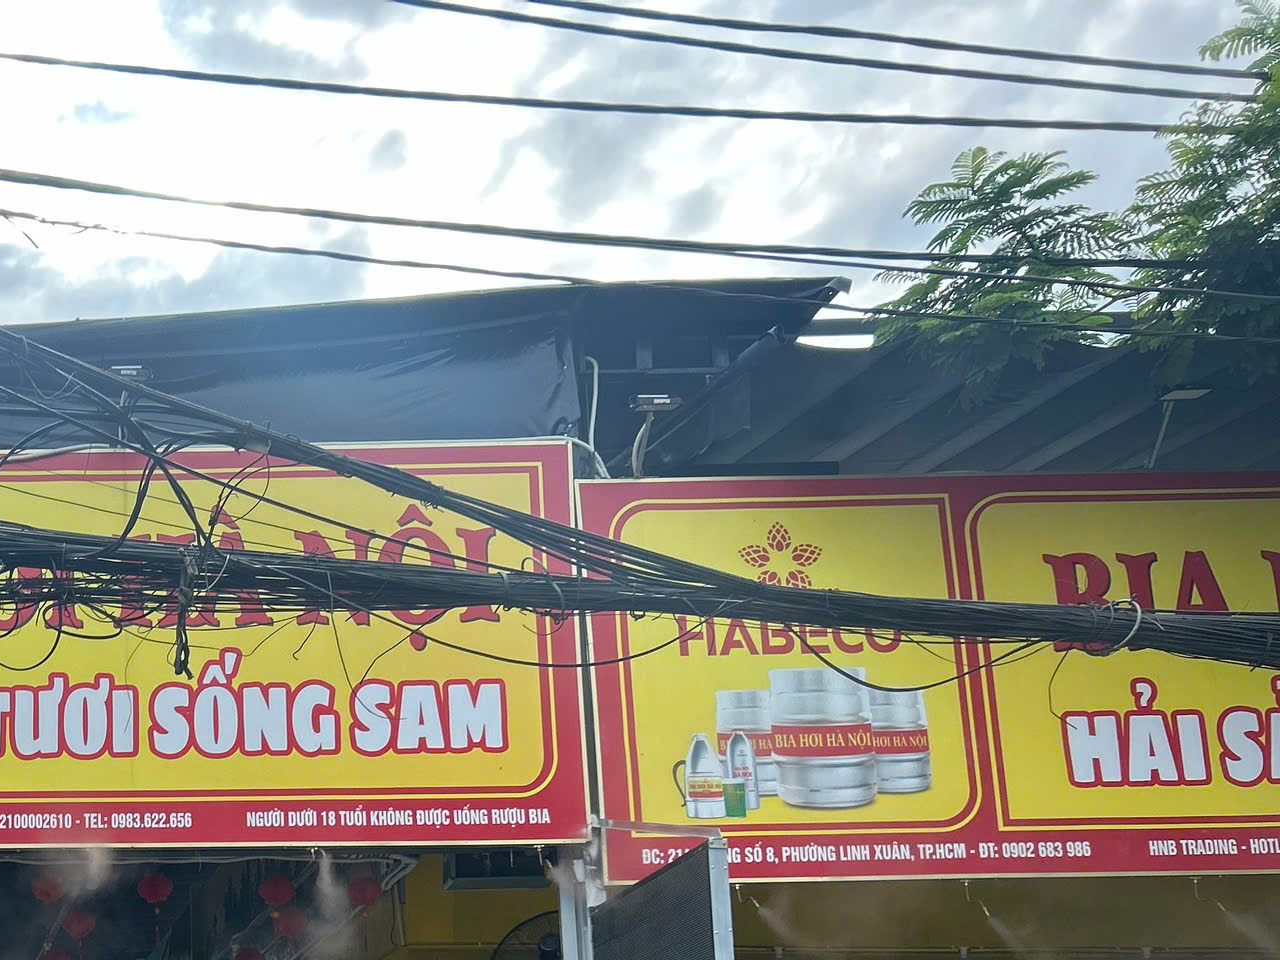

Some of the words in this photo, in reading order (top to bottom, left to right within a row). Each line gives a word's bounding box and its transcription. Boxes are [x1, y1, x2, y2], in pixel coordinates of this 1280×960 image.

[148, 647, 340, 760] SỐNG
[350, 678, 509, 757] SAM
[775, 734, 797, 748] BIA
[826, 729, 845, 747] HÀ
[847, 729, 871, 750] NỘI
[1060, 677, 1212, 788] HẢI
[0, 813, 72, 829] 2100002610
[84, 813, 108, 829] TEL:
[111, 813, 192, 828] 0983.622.656
[246, 808, 285, 827] NGƯỜI
[288, 808, 317, 827] DƯỚI
[321, 811, 336, 826] 18
[339, 804, 367, 826] TUỔI
[370, 807, 413, 826] KHÔNG
[416, 809, 450, 829] ĐƯỢC
[453, 803, 488, 825] UỐNG
[491, 808, 526, 828] RƯỢU
[529, 808, 551, 824] BIA
[642, 849, 664, 865] ĐC:
[744, 842, 763, 864] SỐ
[766, 846, 779, 865] 8,
[782, 841, 836, 863] PHƯỜNG
[840, 845, 870, 861] LINH
[874, 841, 915, 862] XUÂN,
[918, 843, 966, 859] TP.HCM
[979, 842, 999, 858] ĐT:
[1002, 842, 1036, 858] 0902
[1038, 841, 1063, 857] 683
[1066, 841, 1091, 857] 986
[1148, 840, 1177, 856] HNB
[1180, 838, 1238, 855] TRADING
